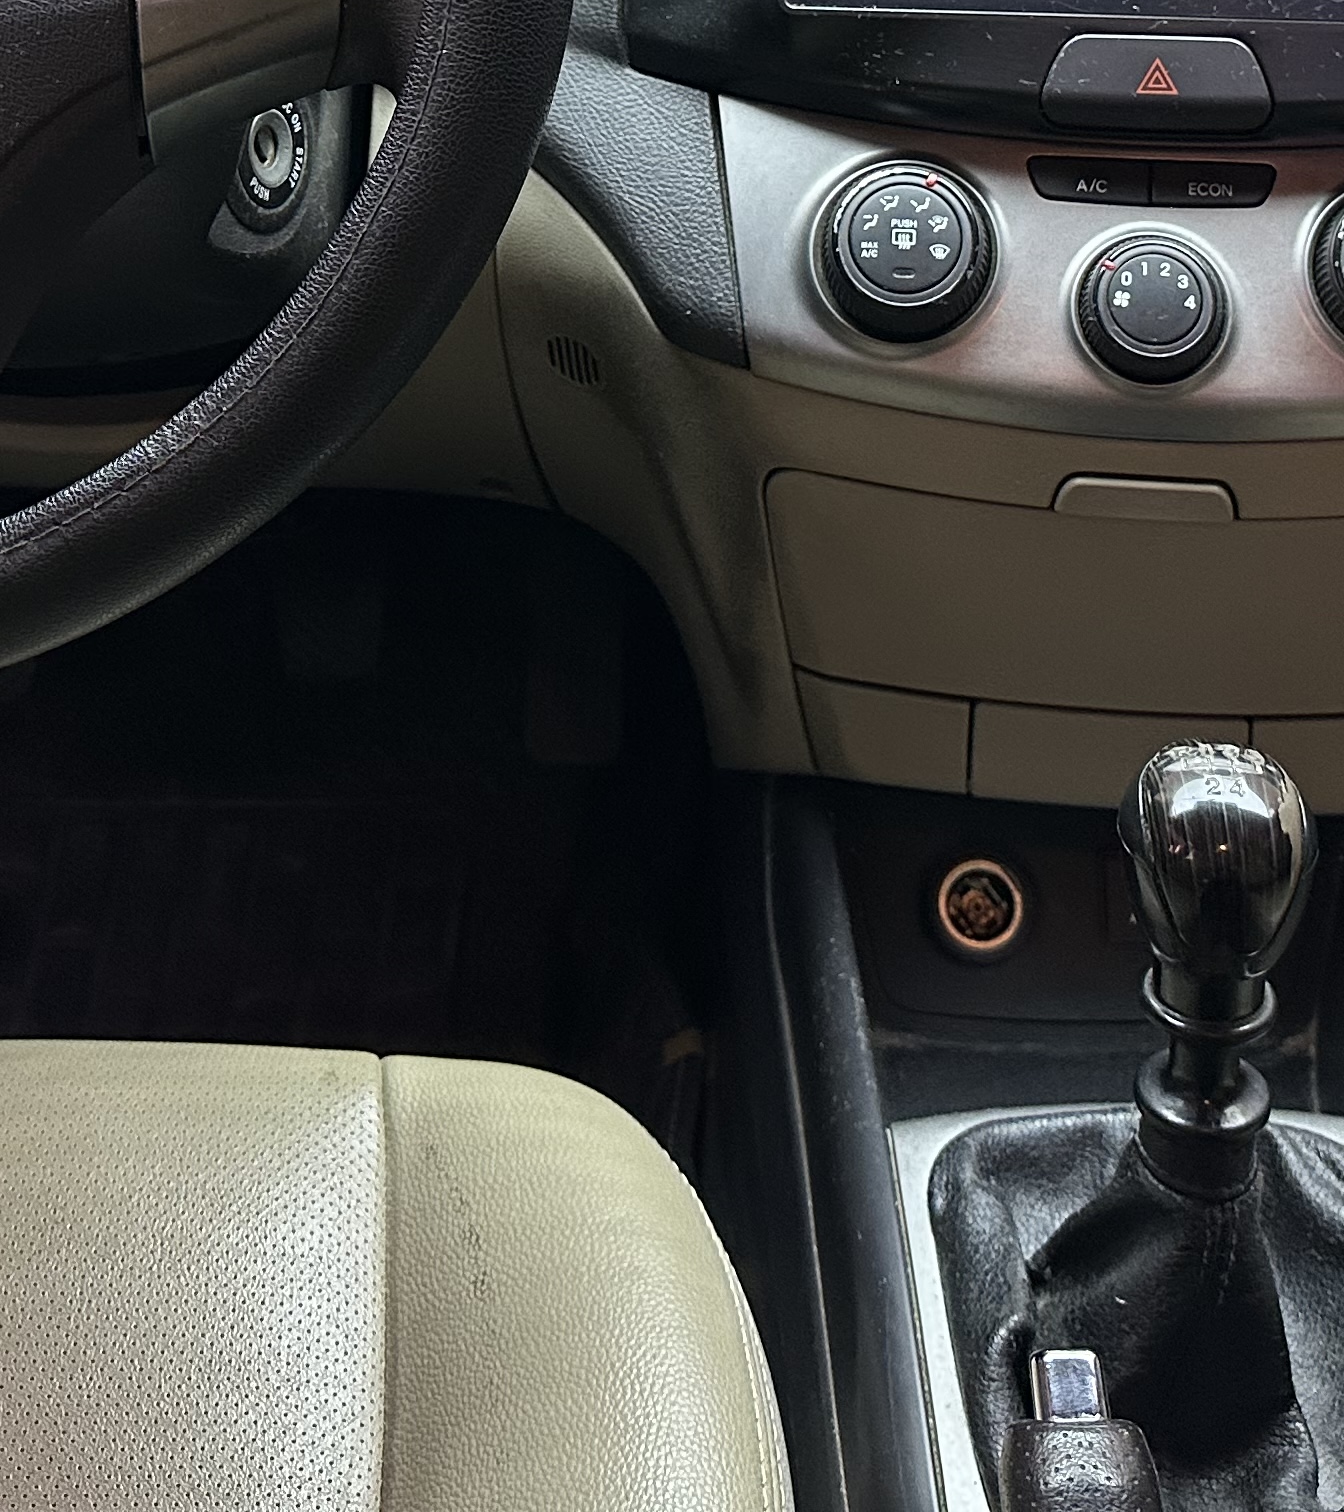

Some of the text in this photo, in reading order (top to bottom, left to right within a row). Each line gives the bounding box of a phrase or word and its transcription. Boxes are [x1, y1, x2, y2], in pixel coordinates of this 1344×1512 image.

[291, 113, 302, 133] ON
[289, 146, 304, 189] START
[249, 176, 271, 202] PUSH
[1075, 178, 1108, 194] A/C
[1187, 182, 1234, 197] ECON
[890, 218, 918, 229] PUSH
[860, 248, 879, 258] A/C
[1141, 261, 1148, 276] 1
[1159, 262, 1171, 277] 2
[1120, 271, 1133, 286] 0
[1177, 274, 1189, 290] 3
[1183, 294, 1197, 310] 4
[1204, 776, 1246, 798] 2 4
